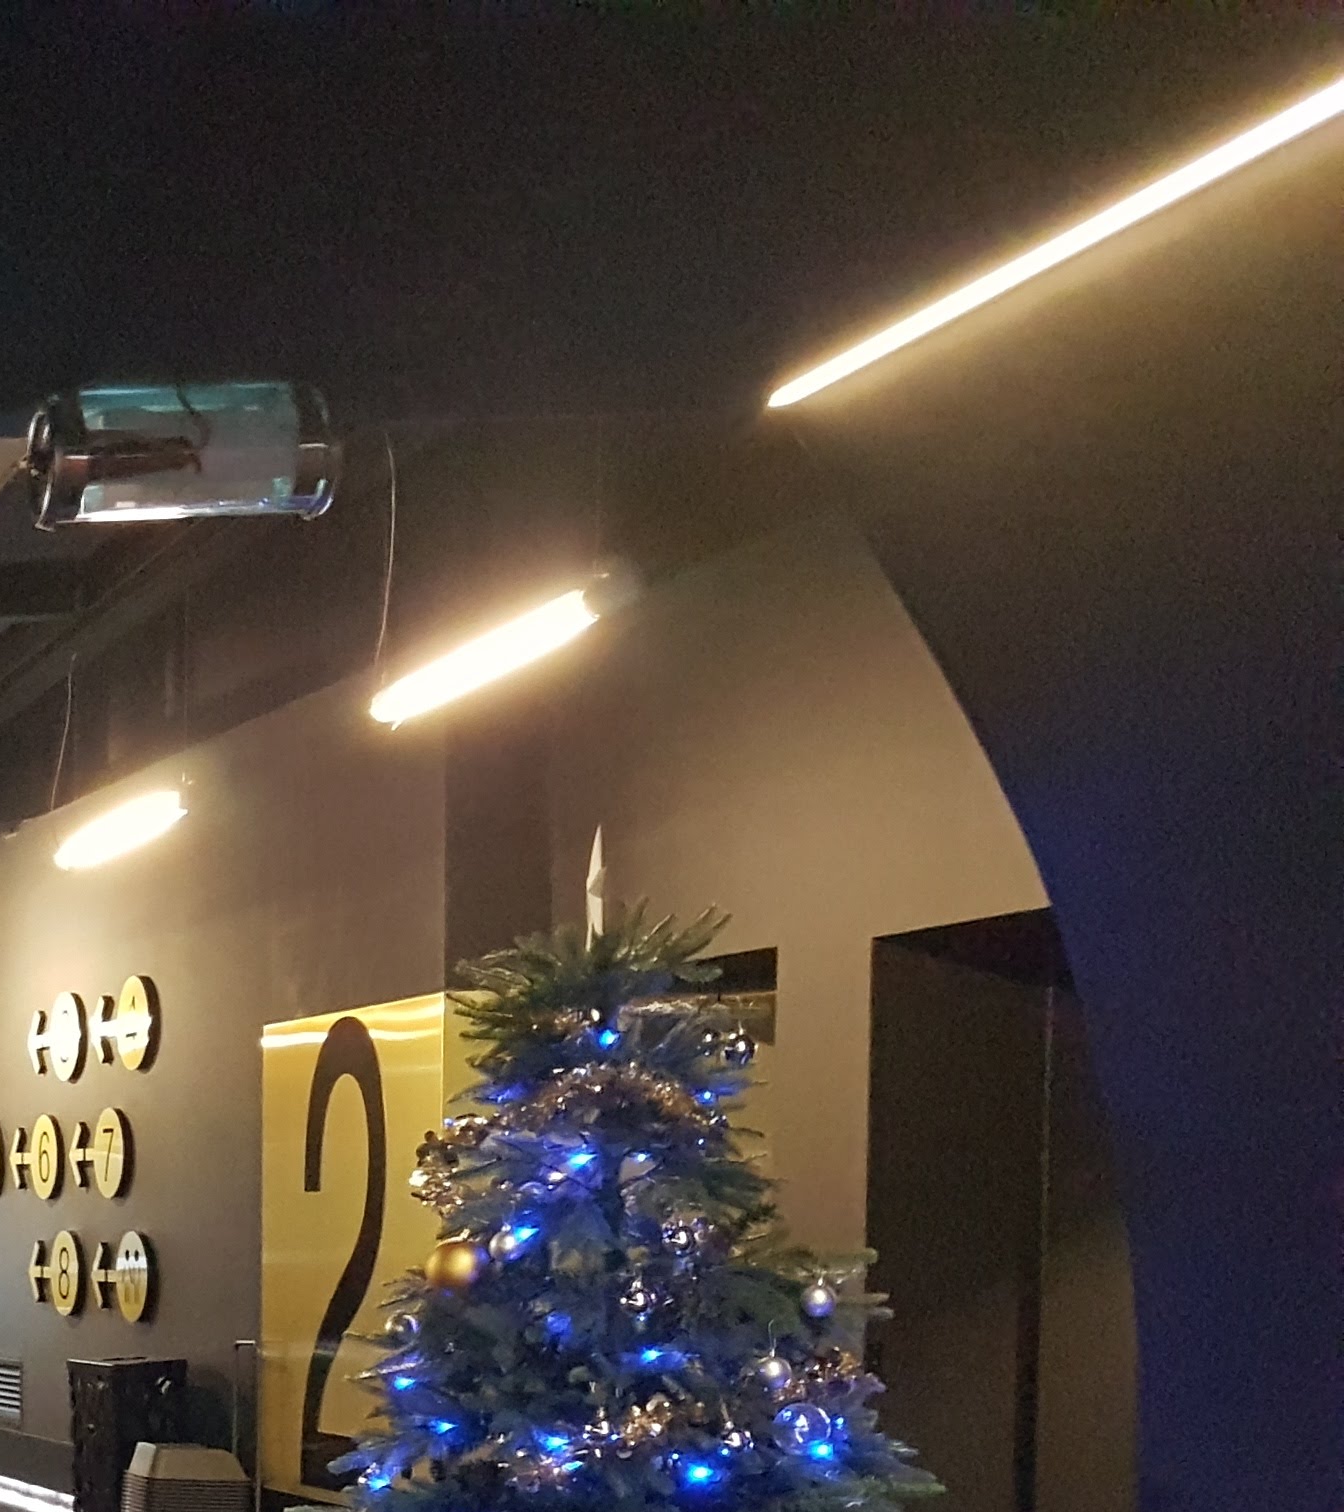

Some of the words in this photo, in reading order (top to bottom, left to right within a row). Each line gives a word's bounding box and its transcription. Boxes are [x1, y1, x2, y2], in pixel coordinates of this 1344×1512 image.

[38, 1131, 50, 1184] 6
[102, 1128, 114, 1182] 7
[59, 1247, 70, 1300] 8
[301, 1016, 388, 1496] 2
